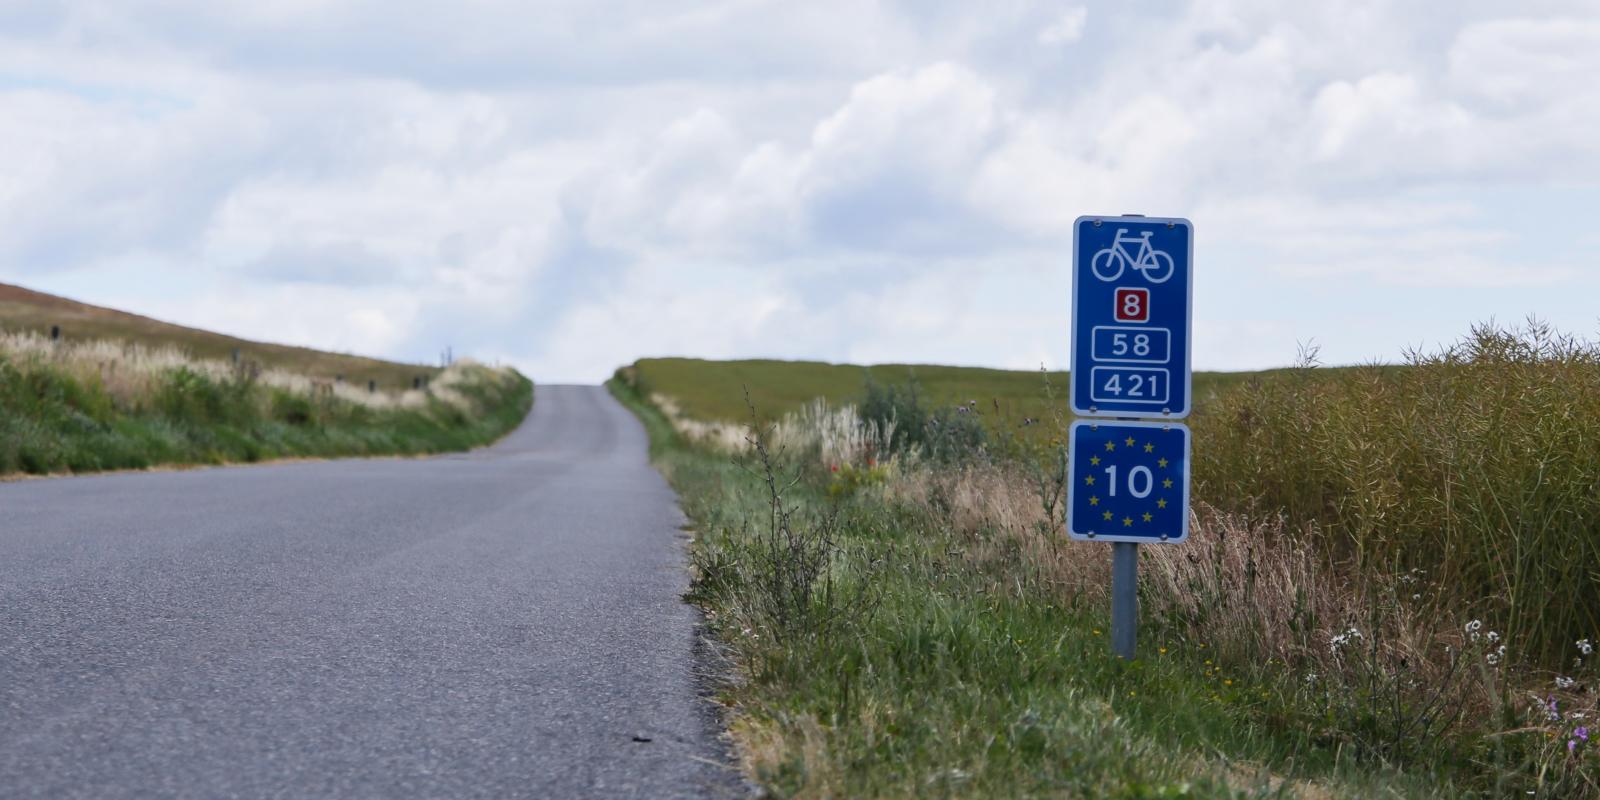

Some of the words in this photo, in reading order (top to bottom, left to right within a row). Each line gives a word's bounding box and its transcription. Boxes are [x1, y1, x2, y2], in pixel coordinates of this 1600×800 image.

[1123, 294, 1141, 317] 8
[1112, 333, 1150, 356] 58
[1103, 374, 1158, 397] 421
[1104, 464, 1154, 499] 10
